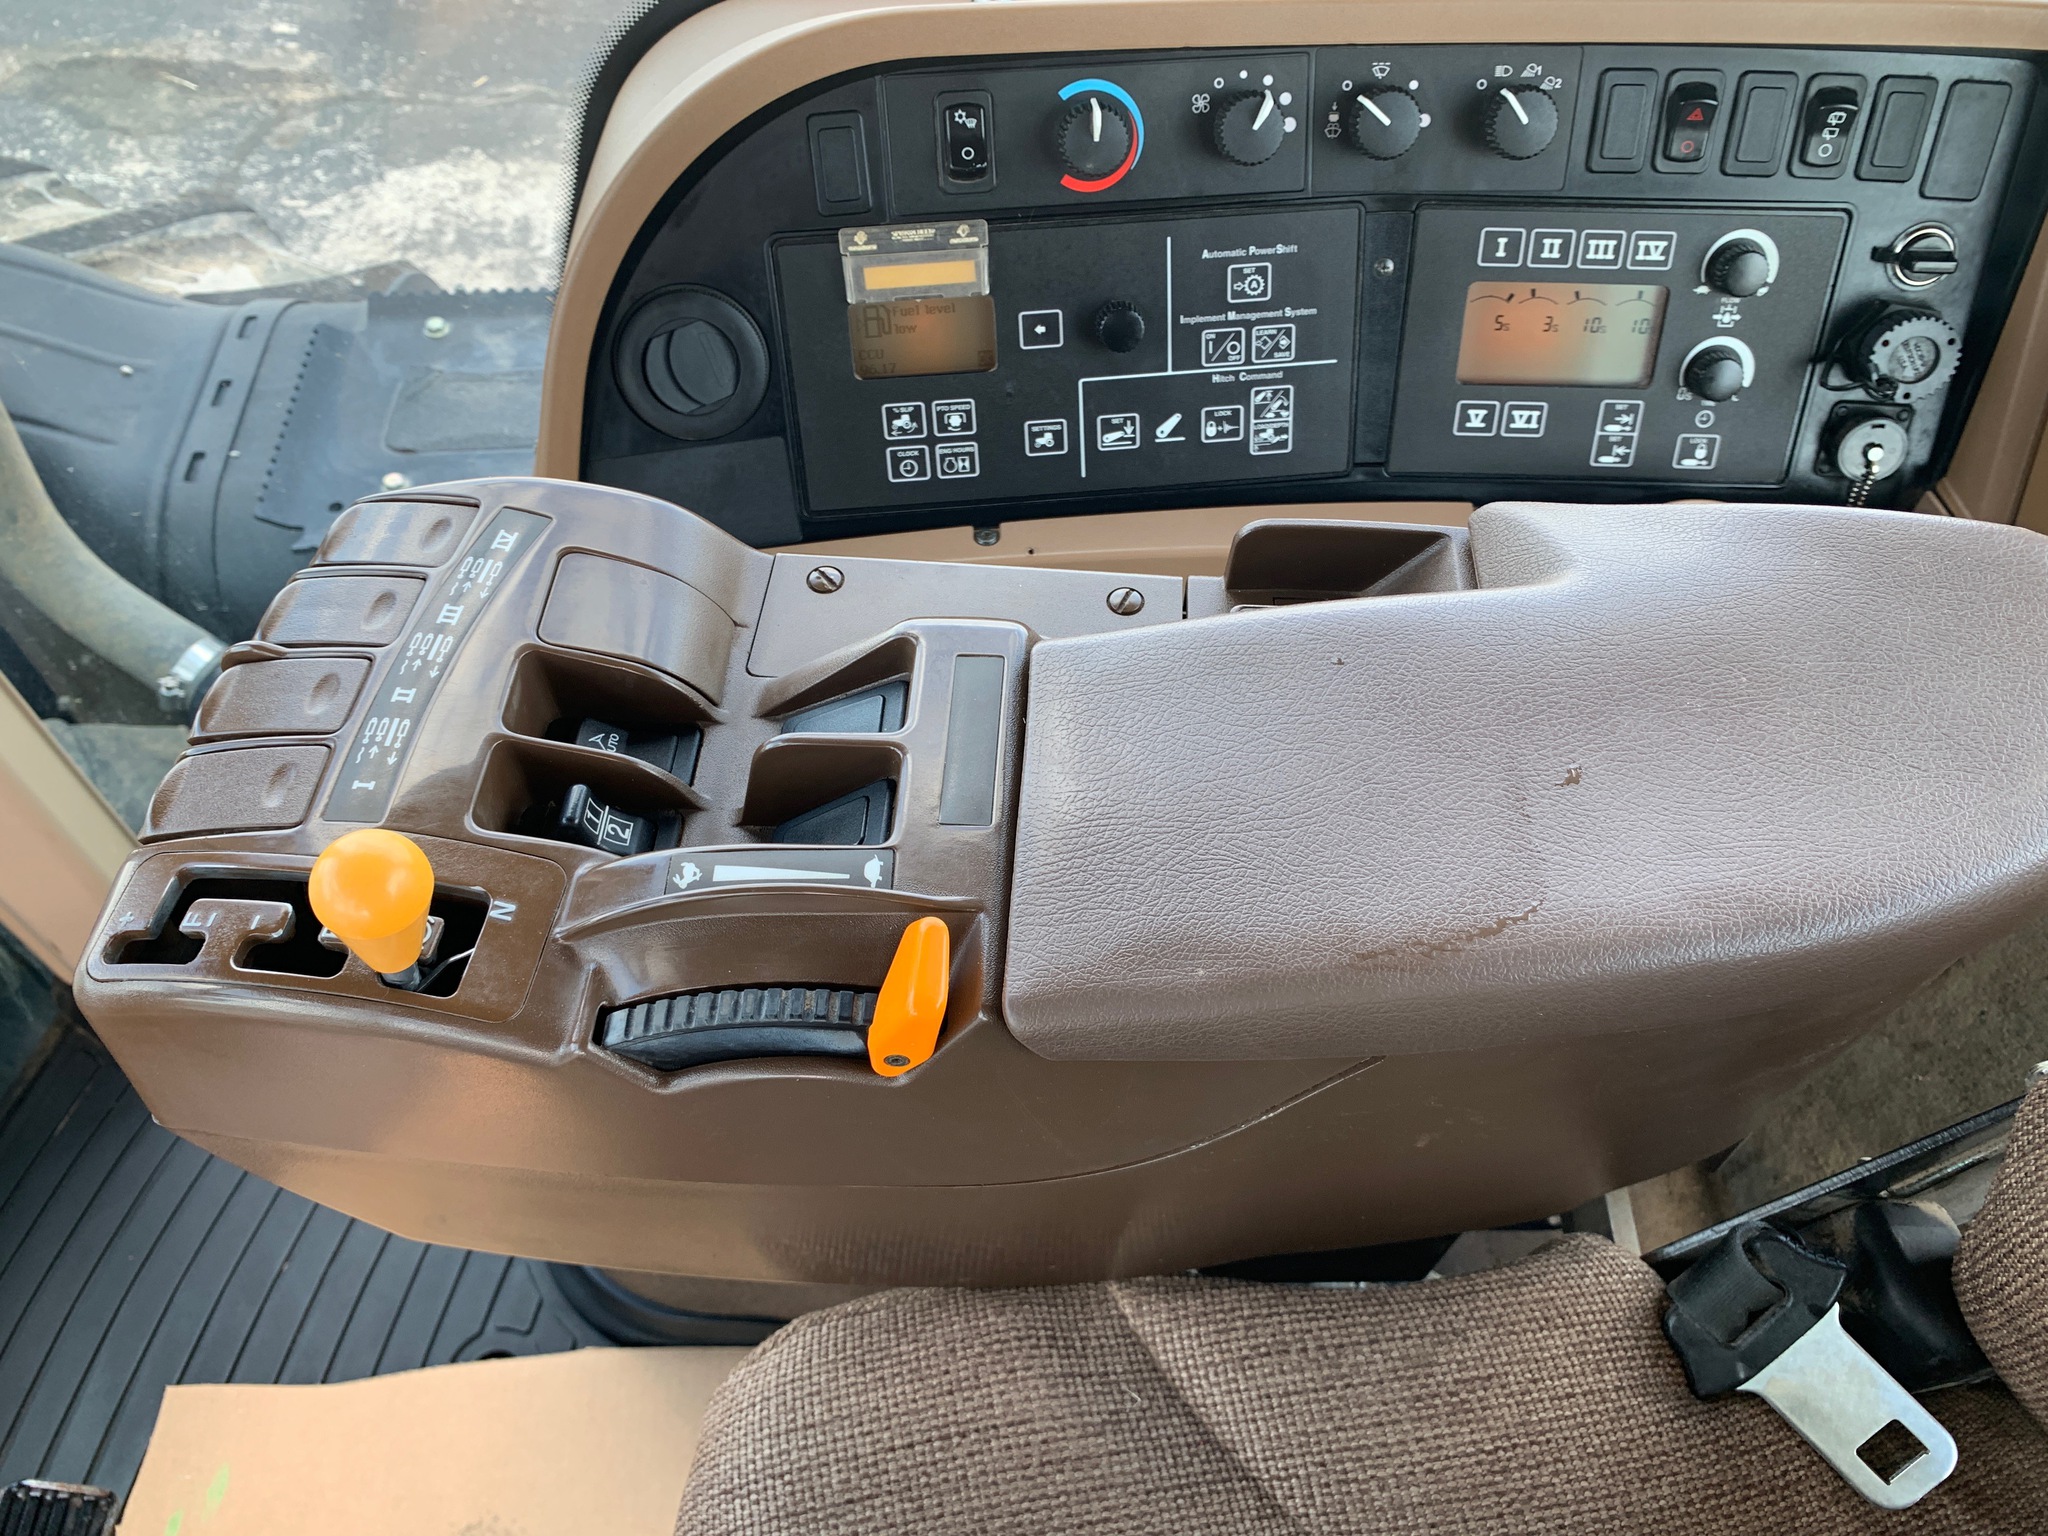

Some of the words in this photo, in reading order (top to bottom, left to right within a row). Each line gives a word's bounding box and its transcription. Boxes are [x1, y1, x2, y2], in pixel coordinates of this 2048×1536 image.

[1201, 248, 1248, 260] Automatic
[1248, 243, 1299, 257] PowerShift
[1495, 237, 1509, 258] I
[1540, 238, 1564, 259] II
[1585, 239, 1618, 260] III
[1634, 240, 1669, 261] IV
[892, 304, 921, 317] Fuel
[924, 302, 956, 315] level
[1179, 314, 1227, 326] Implement
[1226, 309, 1284, 321] Management
[1284, 306, 1318, 319] System
[894, 323, 918, 335] low
[1211, 373, 1236, 384] Hitch
[1238, 370, 1284, 382] Command
[1509, 410, 1542, 430] VI
[491, 529, 519, 552] IV
[436, 603, 465, 626] III
[391, 687, 417, 704] II
[607, 823, 630, 840] 2
[489, 900, 517, 922] N
